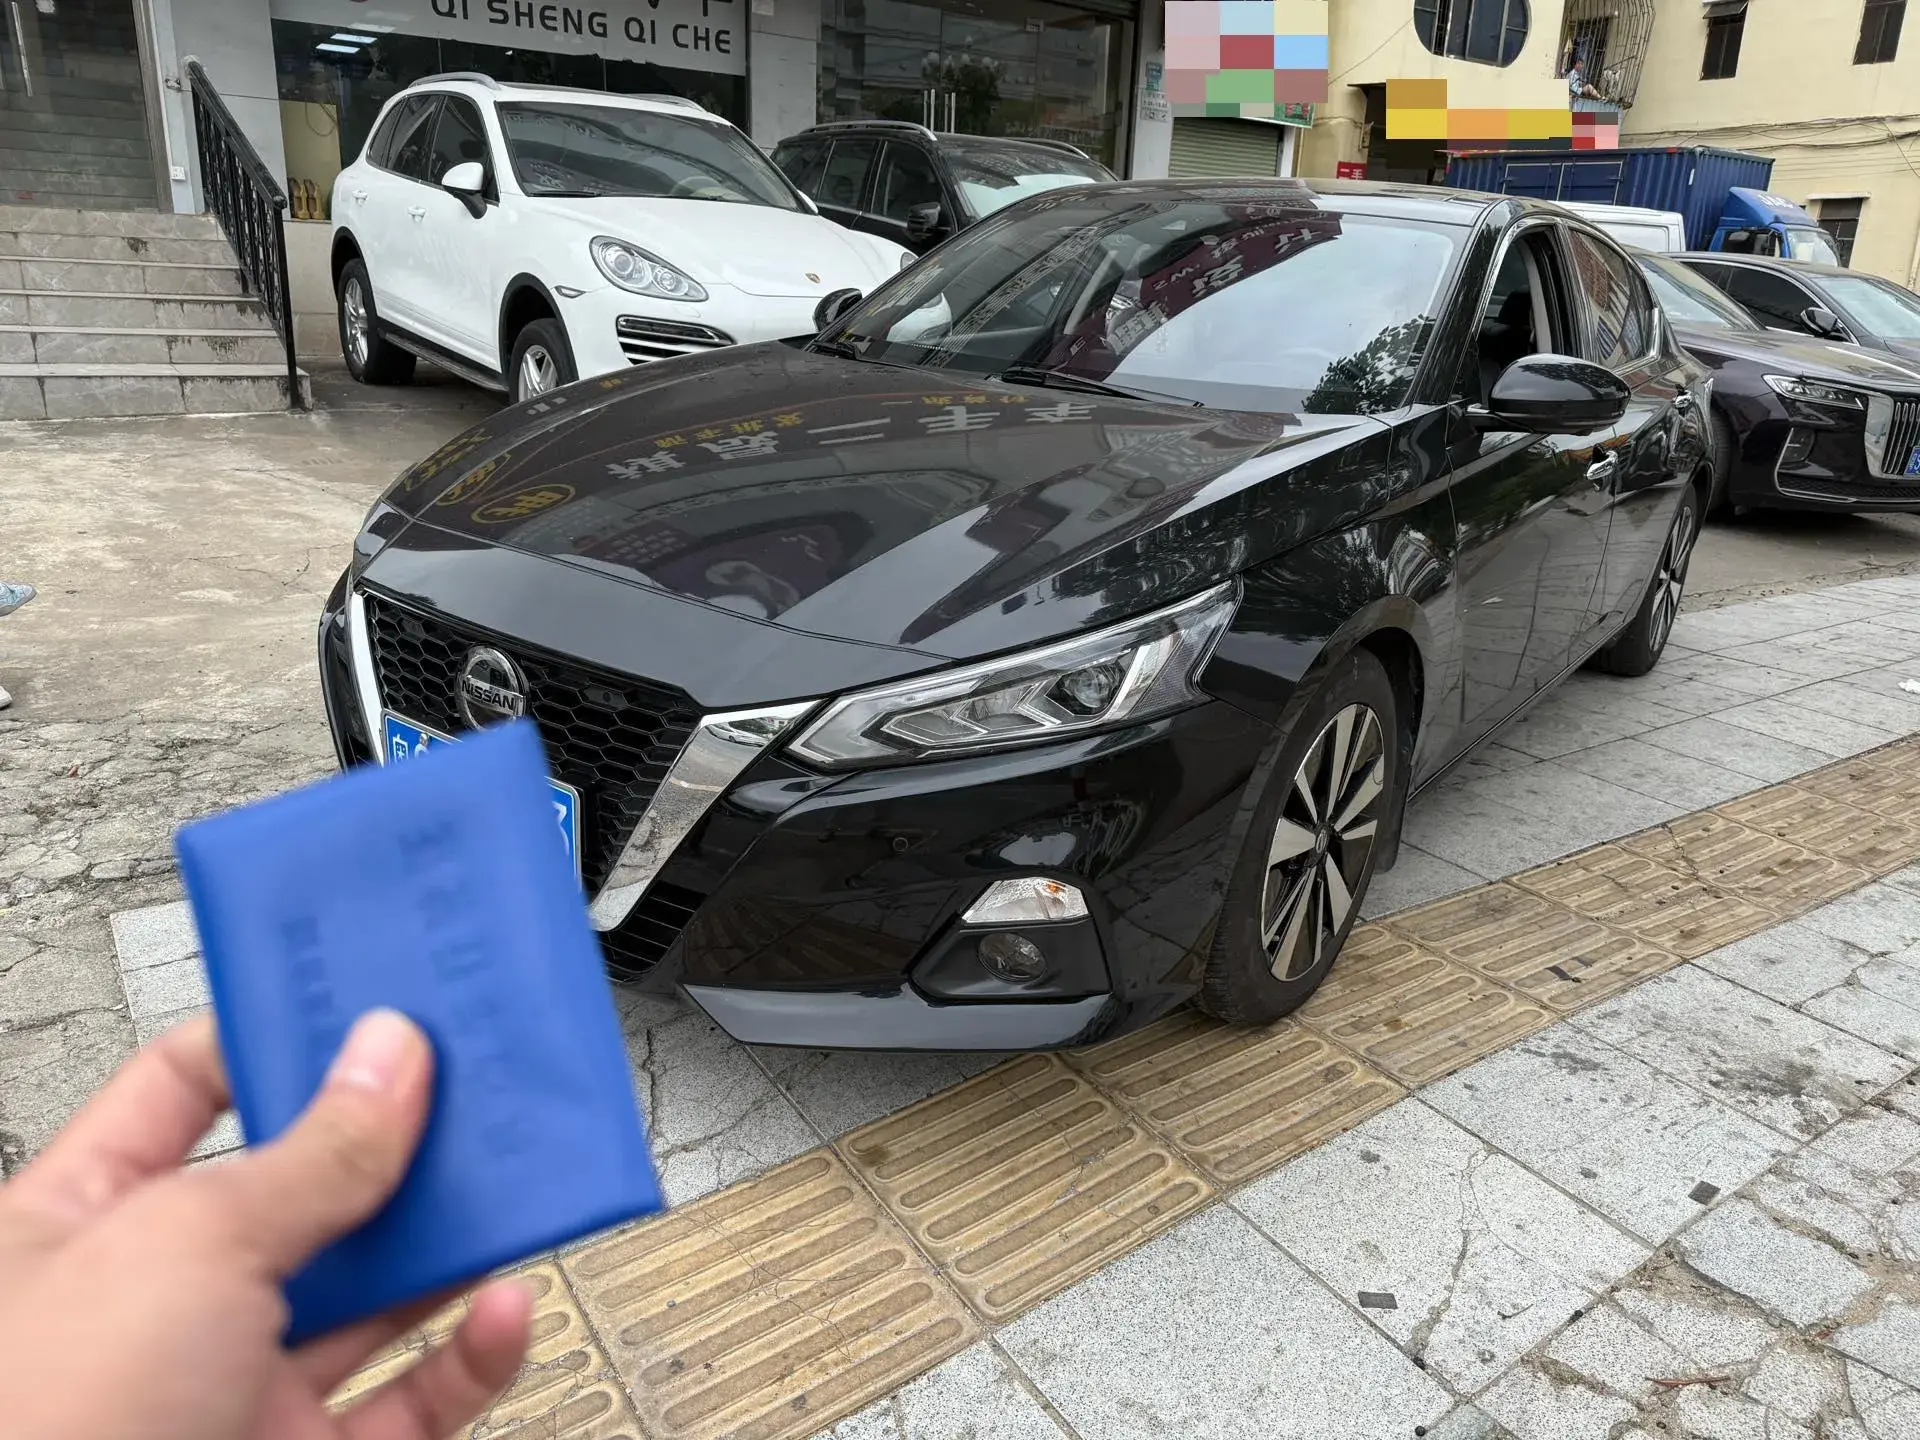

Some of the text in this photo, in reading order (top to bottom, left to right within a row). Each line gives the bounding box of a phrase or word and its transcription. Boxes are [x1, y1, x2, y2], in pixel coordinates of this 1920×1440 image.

[432, 0, 469, 19] QI
[488, 0, 608, 38] SHENG
[624, 17, 656, 45] QI
[672, 23, 731, 55] CHE
[461, 680, 515, 711] NISSAN
